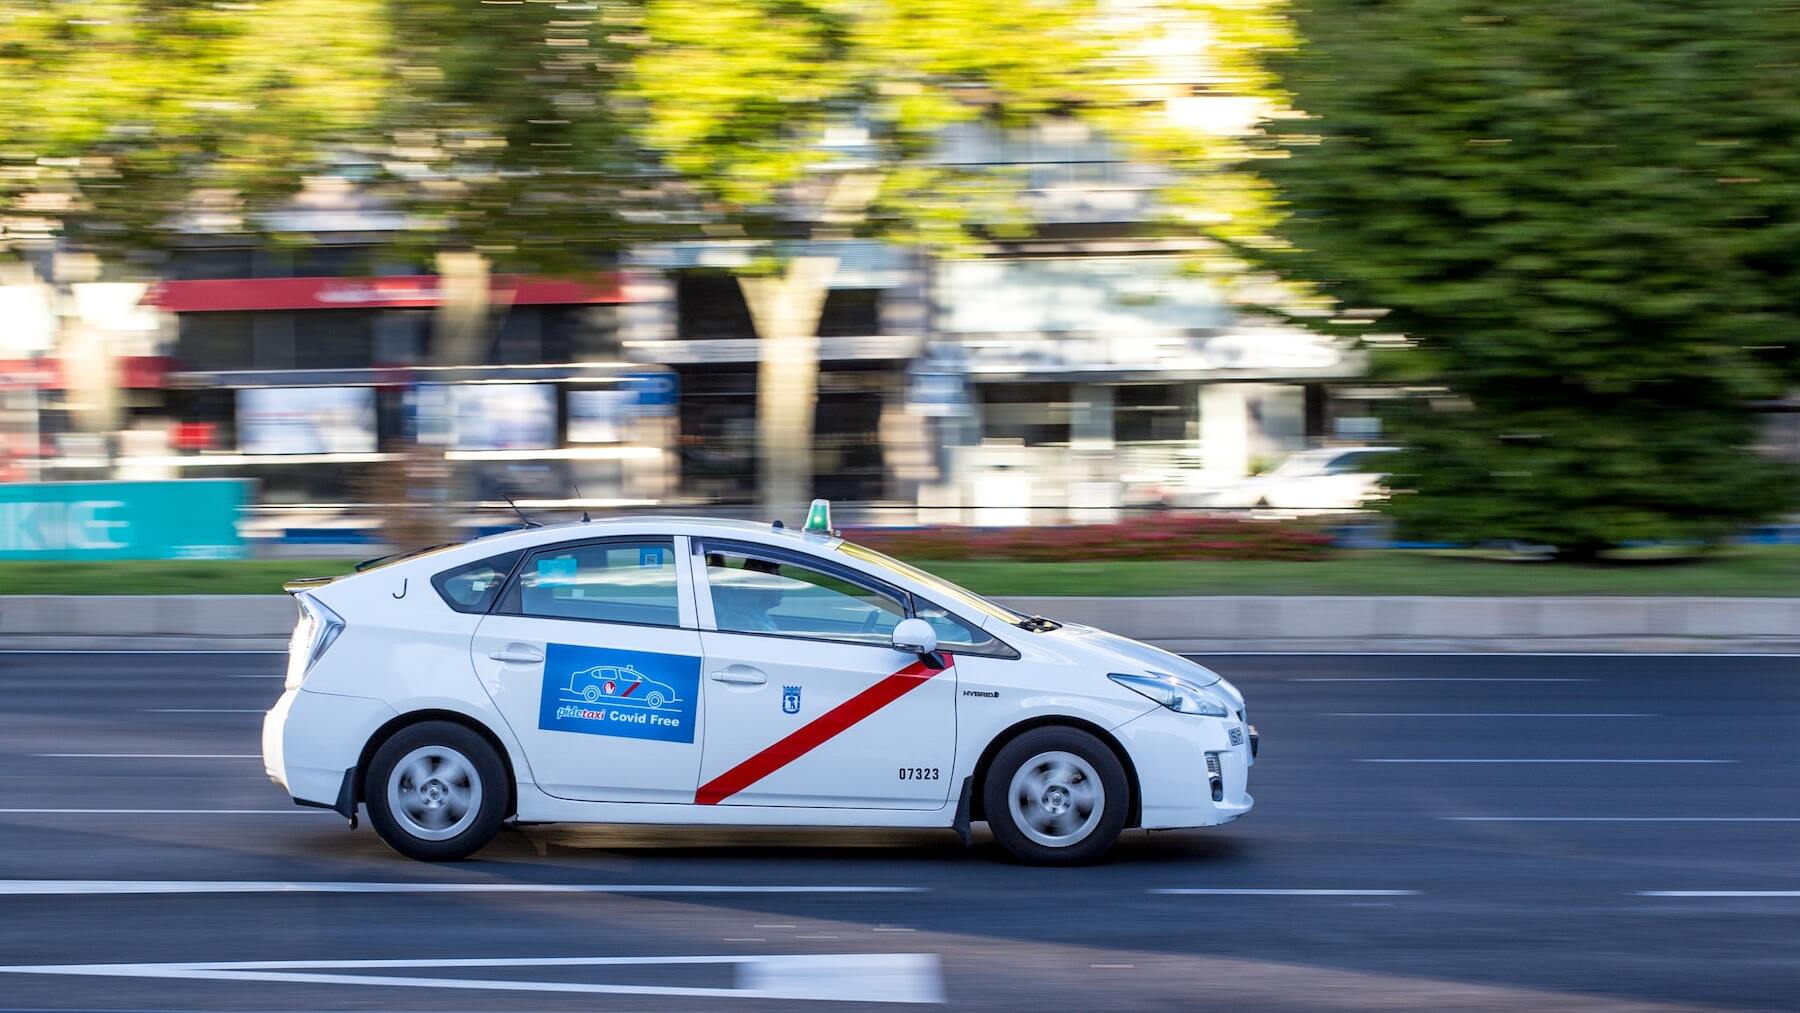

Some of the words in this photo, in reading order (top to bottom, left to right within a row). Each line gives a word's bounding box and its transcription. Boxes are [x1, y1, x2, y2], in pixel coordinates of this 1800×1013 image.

[392, 578, 408, 599] J
[556, 705, 606, 720] pidetaxi
[609, 710, 646, 724] Covid
[650, 714, 680, 727] Free
[899, 768, 939, 780] 07323
